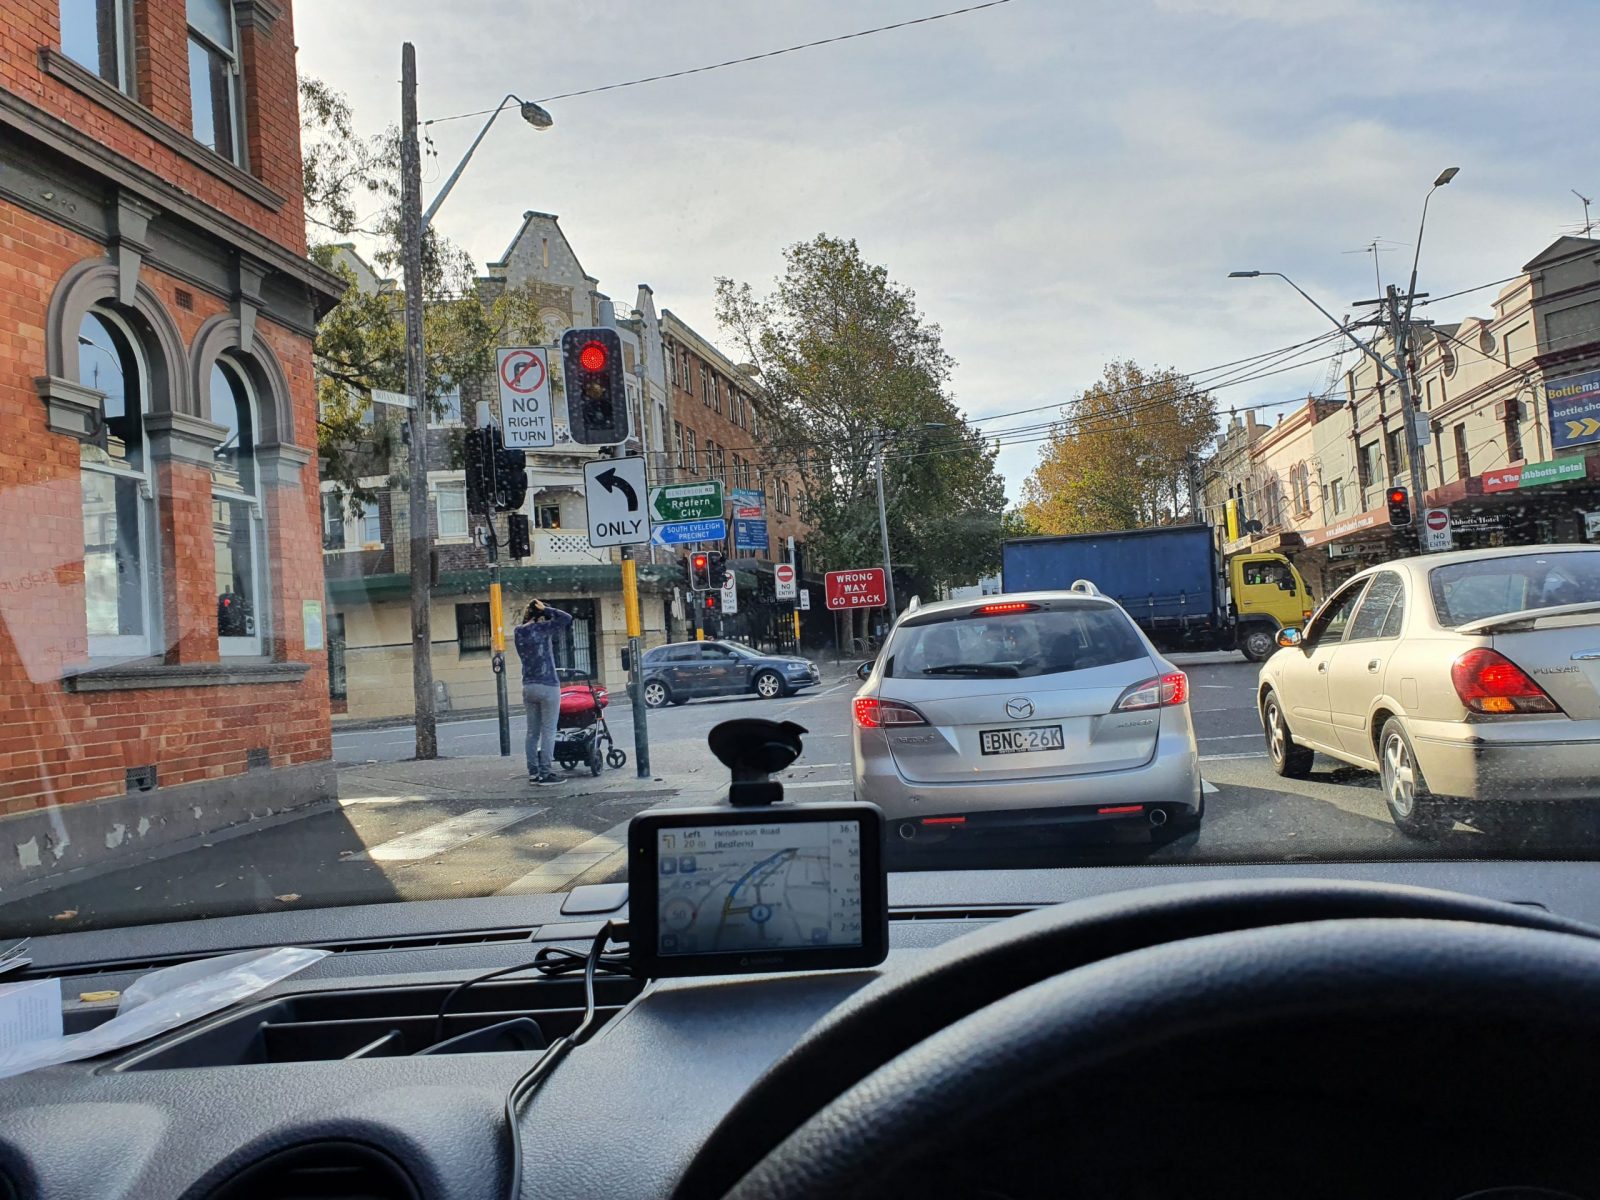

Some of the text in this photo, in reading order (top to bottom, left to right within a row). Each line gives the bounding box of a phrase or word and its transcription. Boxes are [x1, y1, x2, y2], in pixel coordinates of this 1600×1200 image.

[512, 398, 538, 412] NO
[1553, 405, 1583, 418] bottle
[508, 416, 545, 427] RIGHT
[511, 431, 546, 442] TURN
[1503, 474, 1519, 483] The
[1559, 463, 1583, 473] Hotel
[672, 498, 710, 509] Redfern
[681, 509, 702, 518] City
[1479, 515, 1500, 523] Hotel
[596, 519, 642, 538] ONLY
[667, 523, 720, 533] SOUTH EVELEIGH
[679, 531, 709, 540] PRECINCT
[1433, 532, 1446, 540] NO
[1429, 540, 1451, 548] ENTRY
[836, 573, 873, 583] WRONG
[844, 583, 867, 592] WAY
[832, 594, 880, 606] GO BACK
[683, 827, 781, 839] Left Henderson Road
[840, 824, 858, 833] 36.1
[684, 840, 695, 848] 20
[714, 840, 754, 849] (Redfern)
[848, 848, 859, 857] 58
